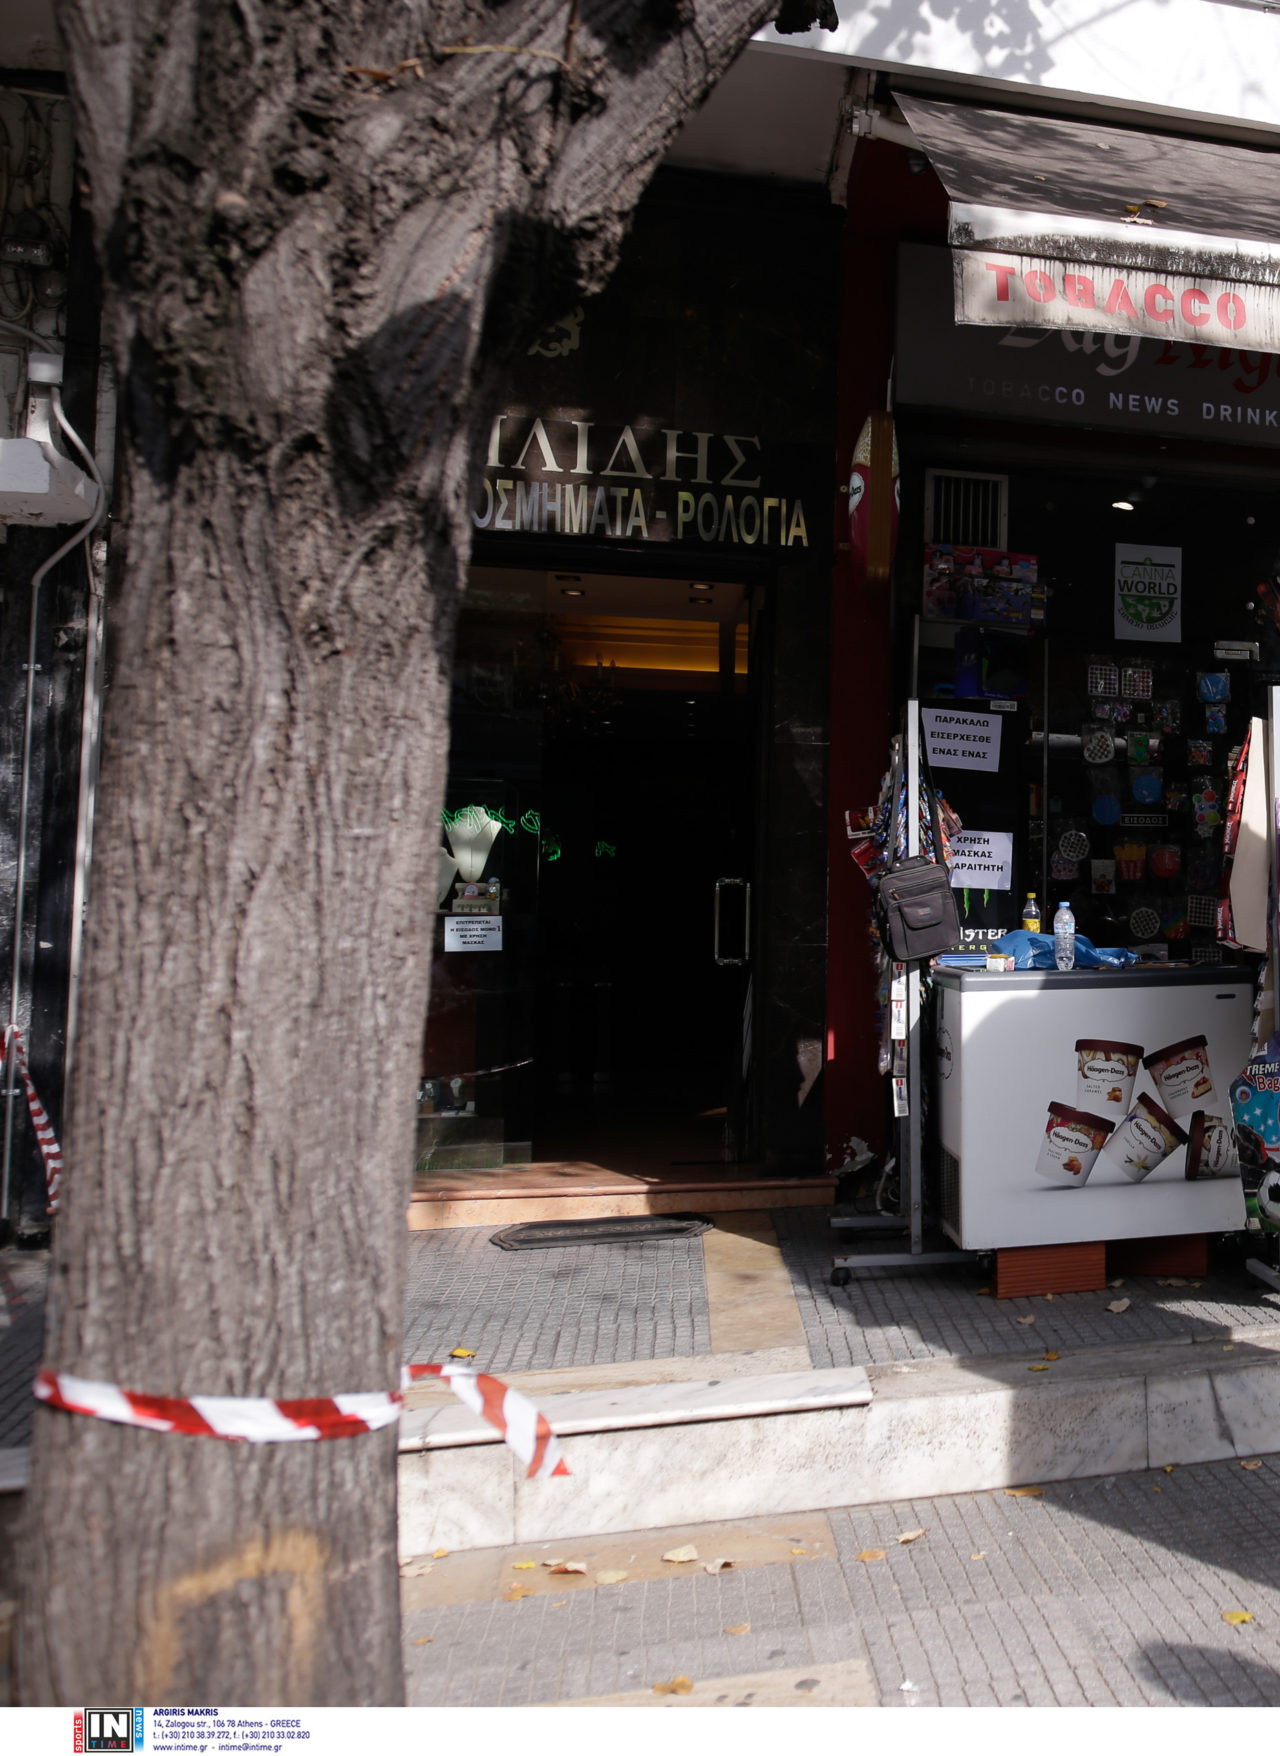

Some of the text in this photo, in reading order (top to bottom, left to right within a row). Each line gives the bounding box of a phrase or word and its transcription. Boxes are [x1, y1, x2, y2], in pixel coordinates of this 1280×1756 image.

[985, 262, 1246, 331] TOBACCO
[967, 376, 1086, 406] TOBACCO
[1109, 392, 1180, 417] NEWS
[678, 491, 808, 548] ΡΟΛΟΓΙΑ
[1120, 565, 1177, 582] CANNA
[1118, 579, 1178, 596] WORLD
[935, 715, 989, 727] ΠΑΡΑΚΑΛΩ
[930, 731, 991, 743] ΕΙΣΕΡΧΕΣΘΕ
[932, 747, 988, 759] ΕΝΑΣ ΕΝΑΣ
[1124, 816, 1164, 824] ΕΙΣΟΔΟΣ
[956, 836, 990, 845] ΧΡΗΣΗ
[952, 849, 993, 858] ΜΑΣΚΑΣ
[1087, 1065, 1125, 1077] Häagen-Dazs
[1163, 1063, 1200, 1081] Häagen-Dazs
[1256, 1075, 1280, 1093] Bag
[1052, 1131, 1089, 1149] Häagen-Dazs
[1134, 1121, 1162, 1151] Häagen-Dazs
